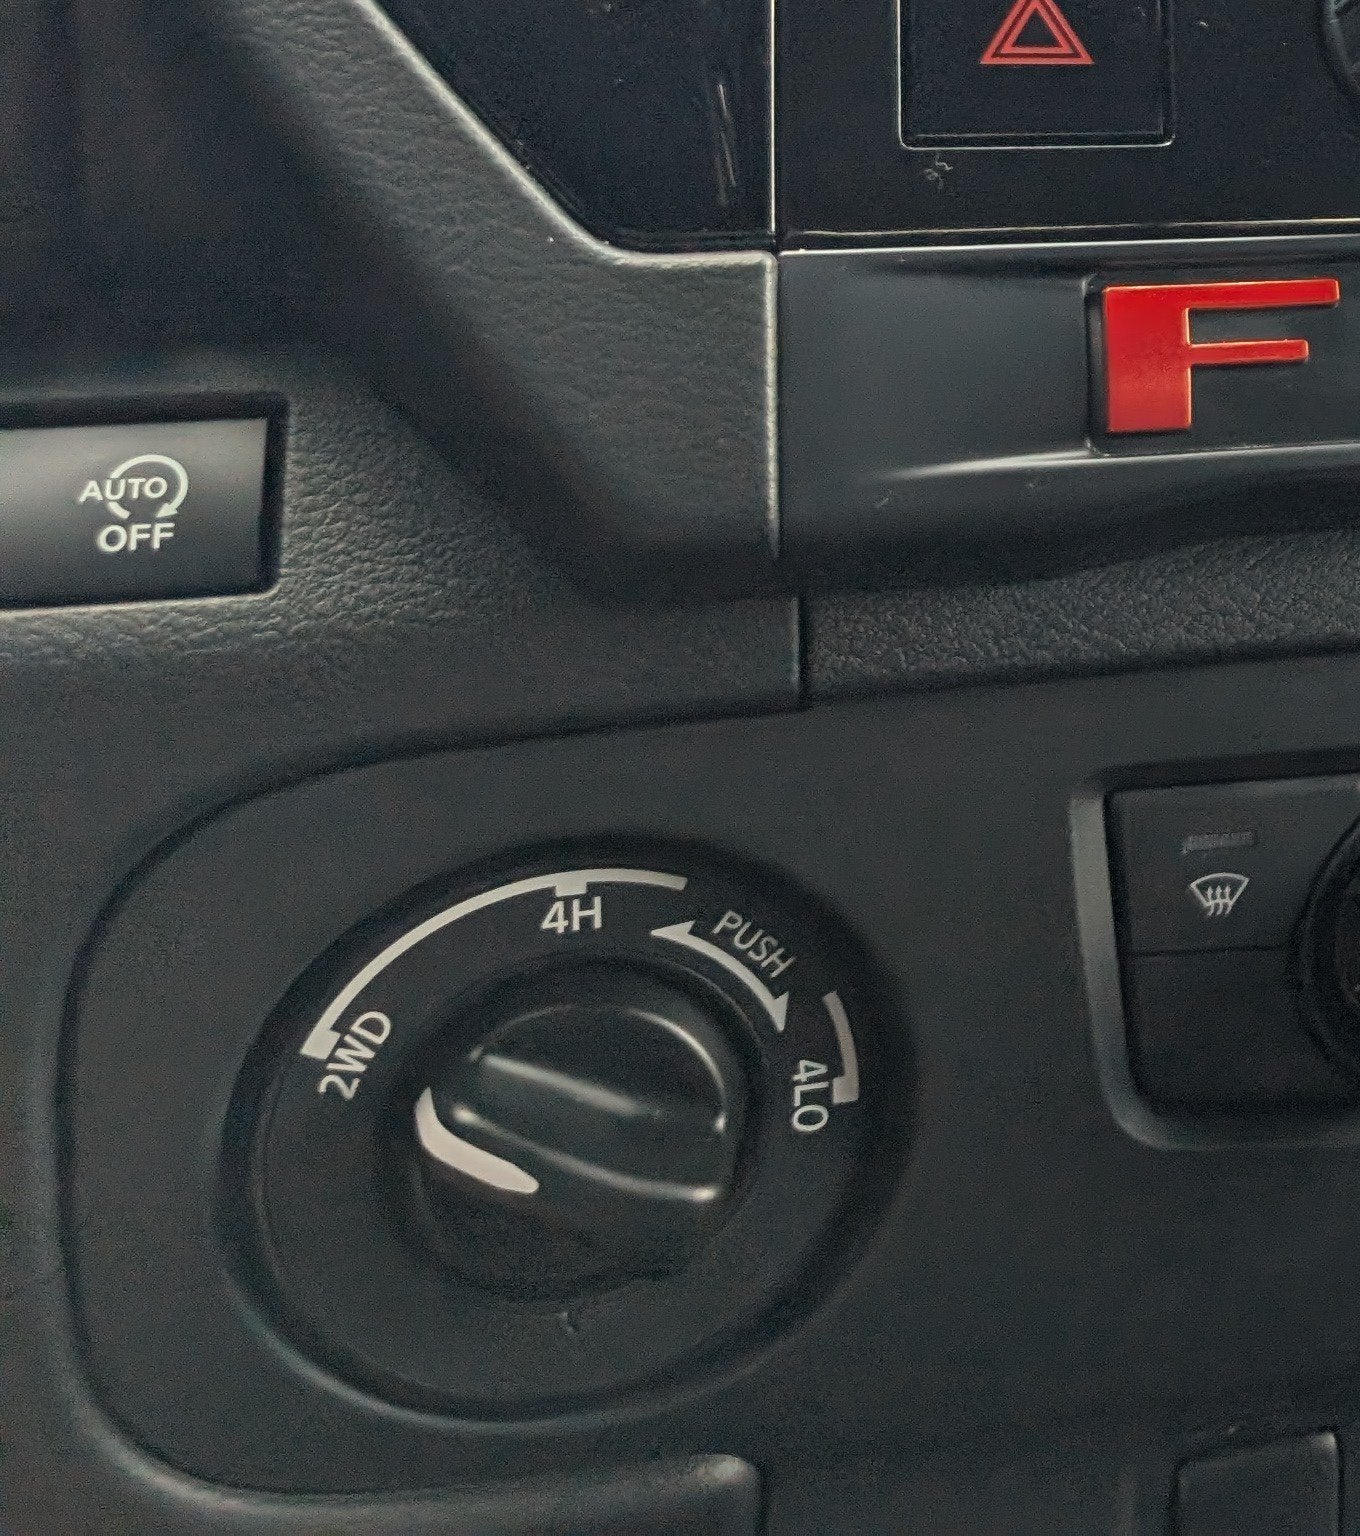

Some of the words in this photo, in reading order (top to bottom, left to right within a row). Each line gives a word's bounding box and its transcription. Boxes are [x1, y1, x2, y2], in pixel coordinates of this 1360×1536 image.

[78, 474, 168, 503] AUTO
[97, 521, 175, 552] OFF
[541, 896, 603, 934] 4H
[711, 910, 795, 979] PUSH
[317, 1009, 393, 1101] 2WD
[790, 1057, 829, 1133] 4LO
